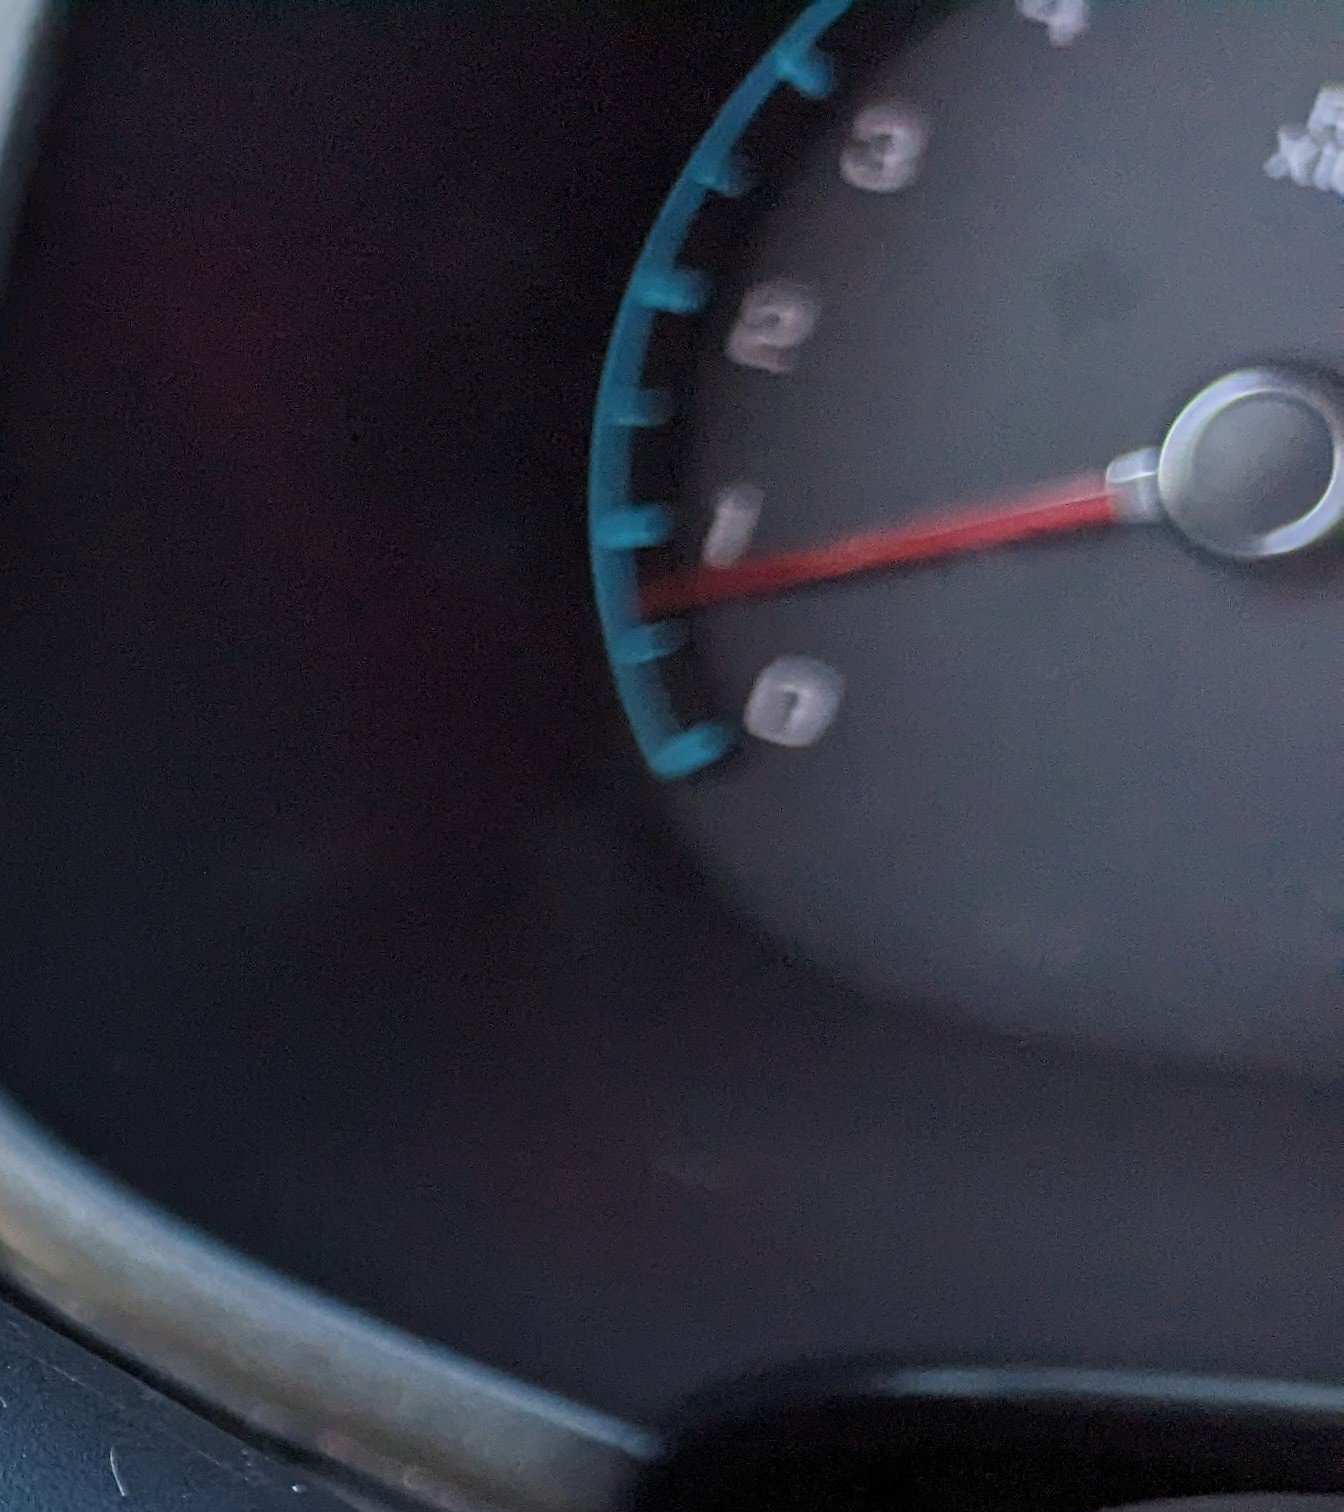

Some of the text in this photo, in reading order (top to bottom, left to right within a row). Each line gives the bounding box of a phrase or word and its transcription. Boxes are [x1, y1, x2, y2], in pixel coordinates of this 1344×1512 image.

[840, 106, 926, 192] 3
[726, 280, 814, 373] 2
[704, 483, 762, 569] 1
[744, 656, 842, 747] 0
